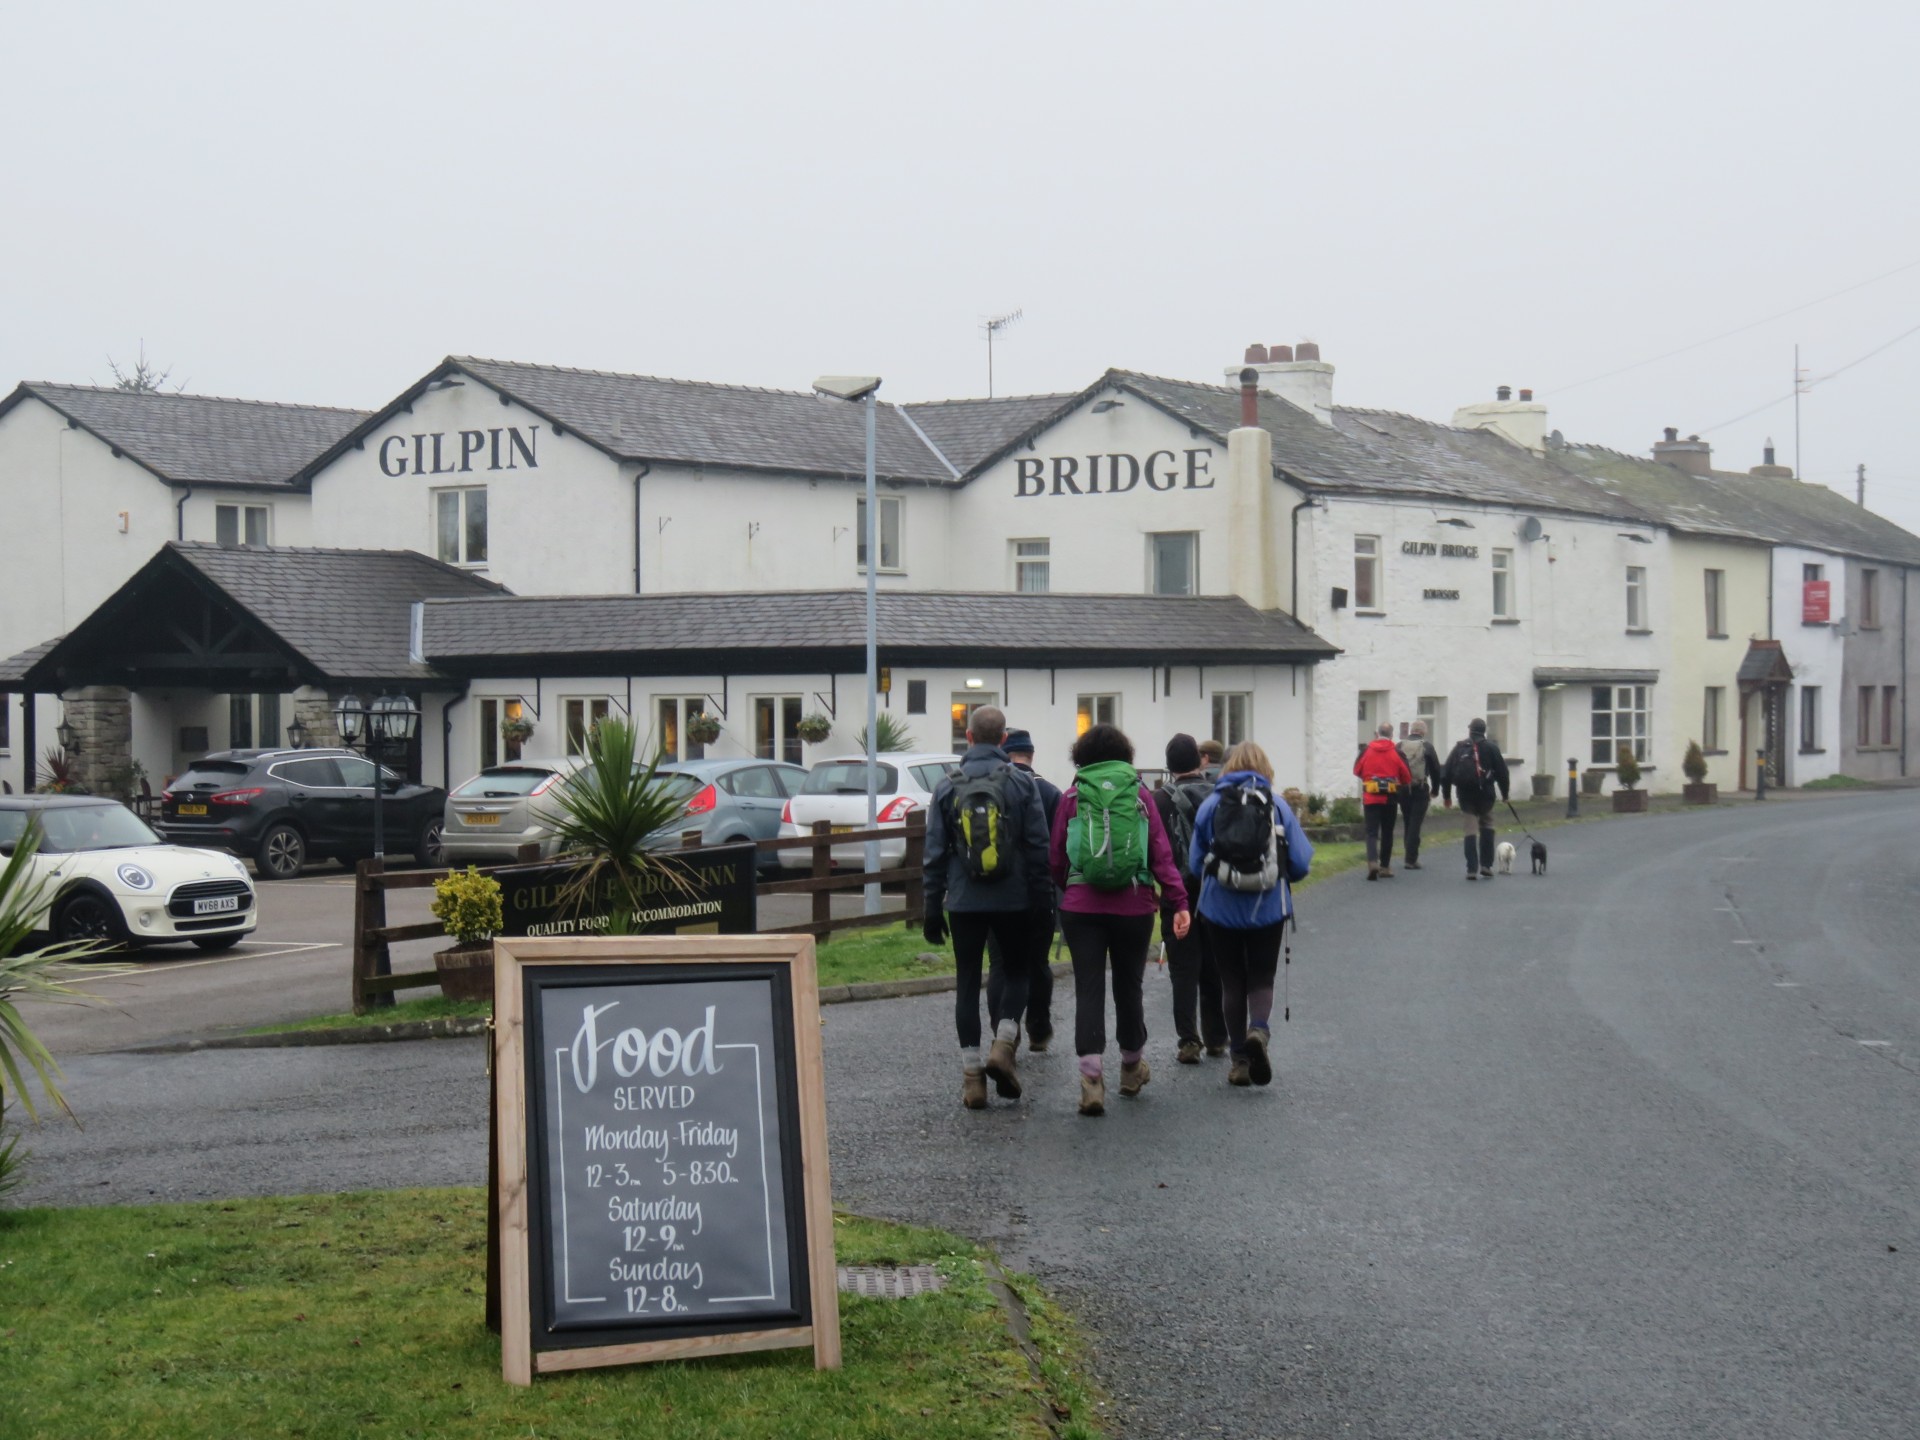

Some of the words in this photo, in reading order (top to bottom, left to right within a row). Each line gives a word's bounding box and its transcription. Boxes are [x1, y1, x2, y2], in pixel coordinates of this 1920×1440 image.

[379, 426, 539, 477] GILPIN
[1014, 448, 1215, 497] BRIDGE
[1402, 541, 1437, 556] GILPIN
[1441, 543, 1479, 558] BRIDGE
[700, 863, 737, 889] INN
[220, 898, 235, 910] AXS
[527, 920, 576, 937] QUALITY
[579, 915, 610, 931] FOOD
[572, 1001, 724, 1093] Food
[614, 1085, 695, 1111] SERVED
[608, 1195, 703, 1235] Saturday
[609, 1257, 703, 1289] Sunday
